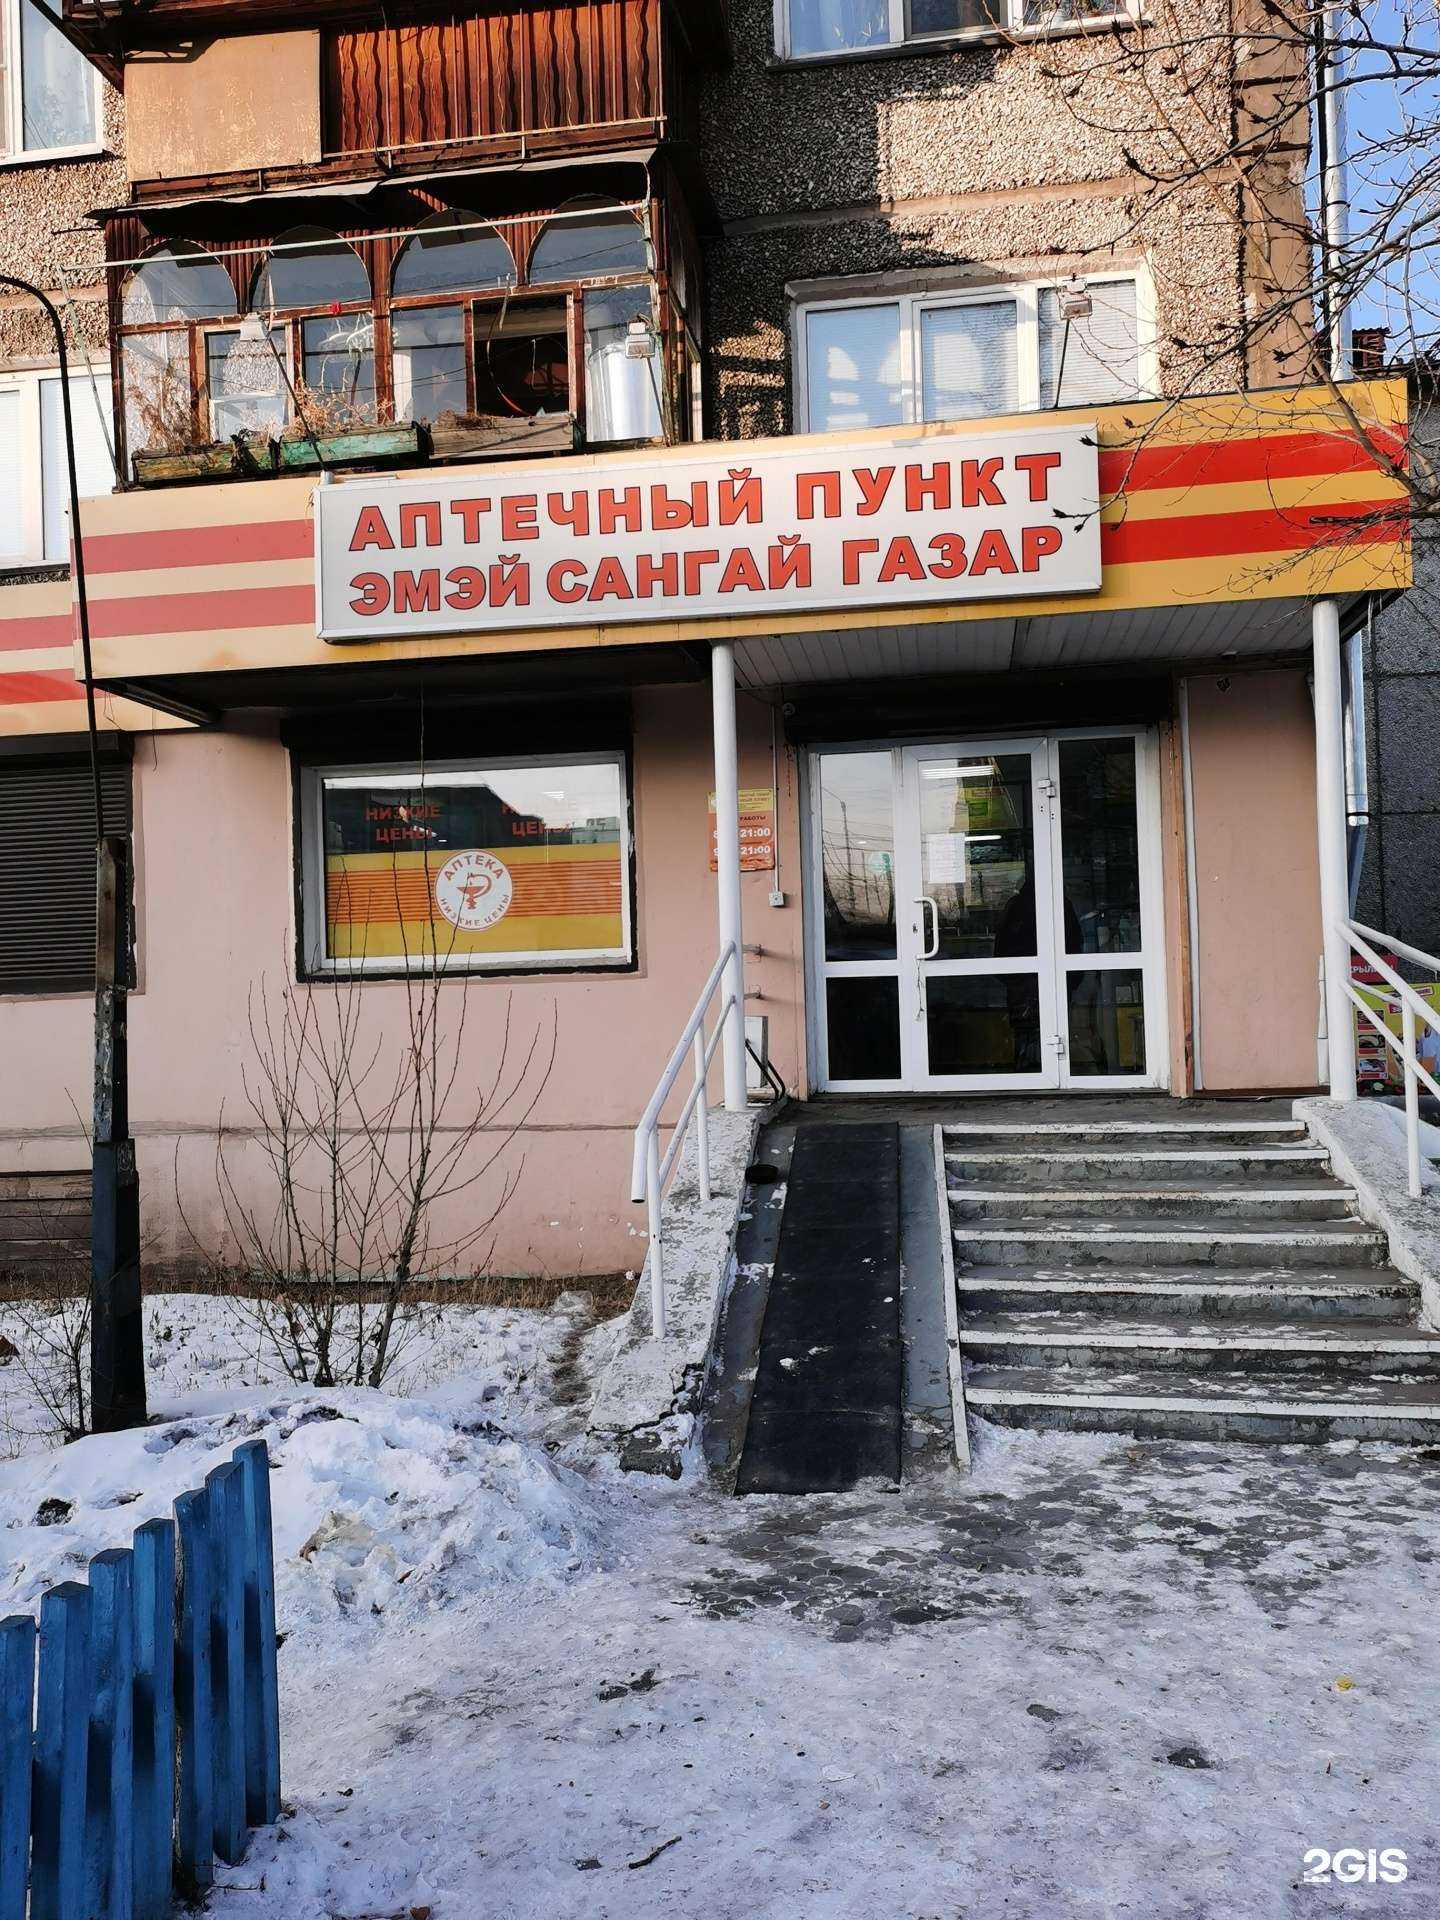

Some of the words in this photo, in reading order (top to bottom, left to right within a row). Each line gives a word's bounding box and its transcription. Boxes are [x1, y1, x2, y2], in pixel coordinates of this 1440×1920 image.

[348, 467, 764, 552] АПТЕЧНЫЙ
[796, 451, 1062, 520] ПУНКТ
[348, 553, 531, 617] ЭМЭЙ
[546, 534, 812, 604] САНГАЙ
[842, 525, 1063, 586] ГАЗАР
[376, 826, 433, 844] ЦЕНЫ
[740, 827, 771, 838] 21:00
[740, 845, 771, 855] 21:00
[444, 854, 504, 881] АПТЕКА
